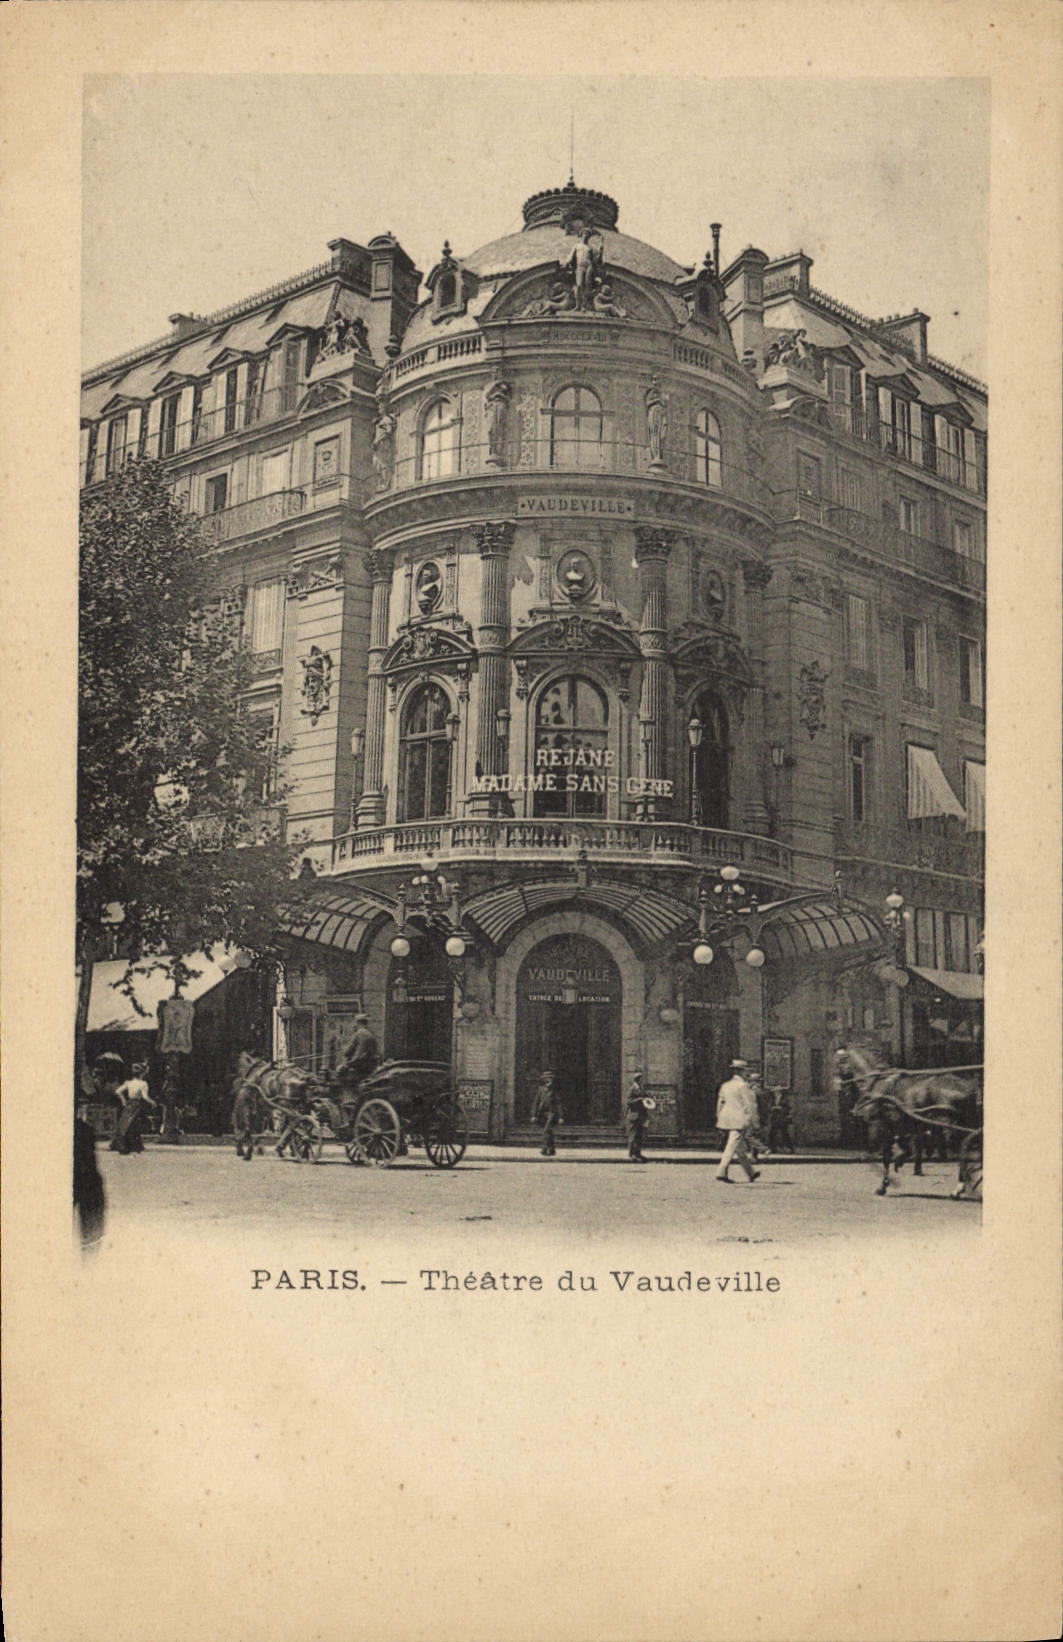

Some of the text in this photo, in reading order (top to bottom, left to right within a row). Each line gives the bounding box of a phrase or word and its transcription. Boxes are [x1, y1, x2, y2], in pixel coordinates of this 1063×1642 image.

[527, 499, 625, 514] VAUDEVILLE
[471, 774, 557, 793] MADAME
[566, 774, 620, 793] SANS
